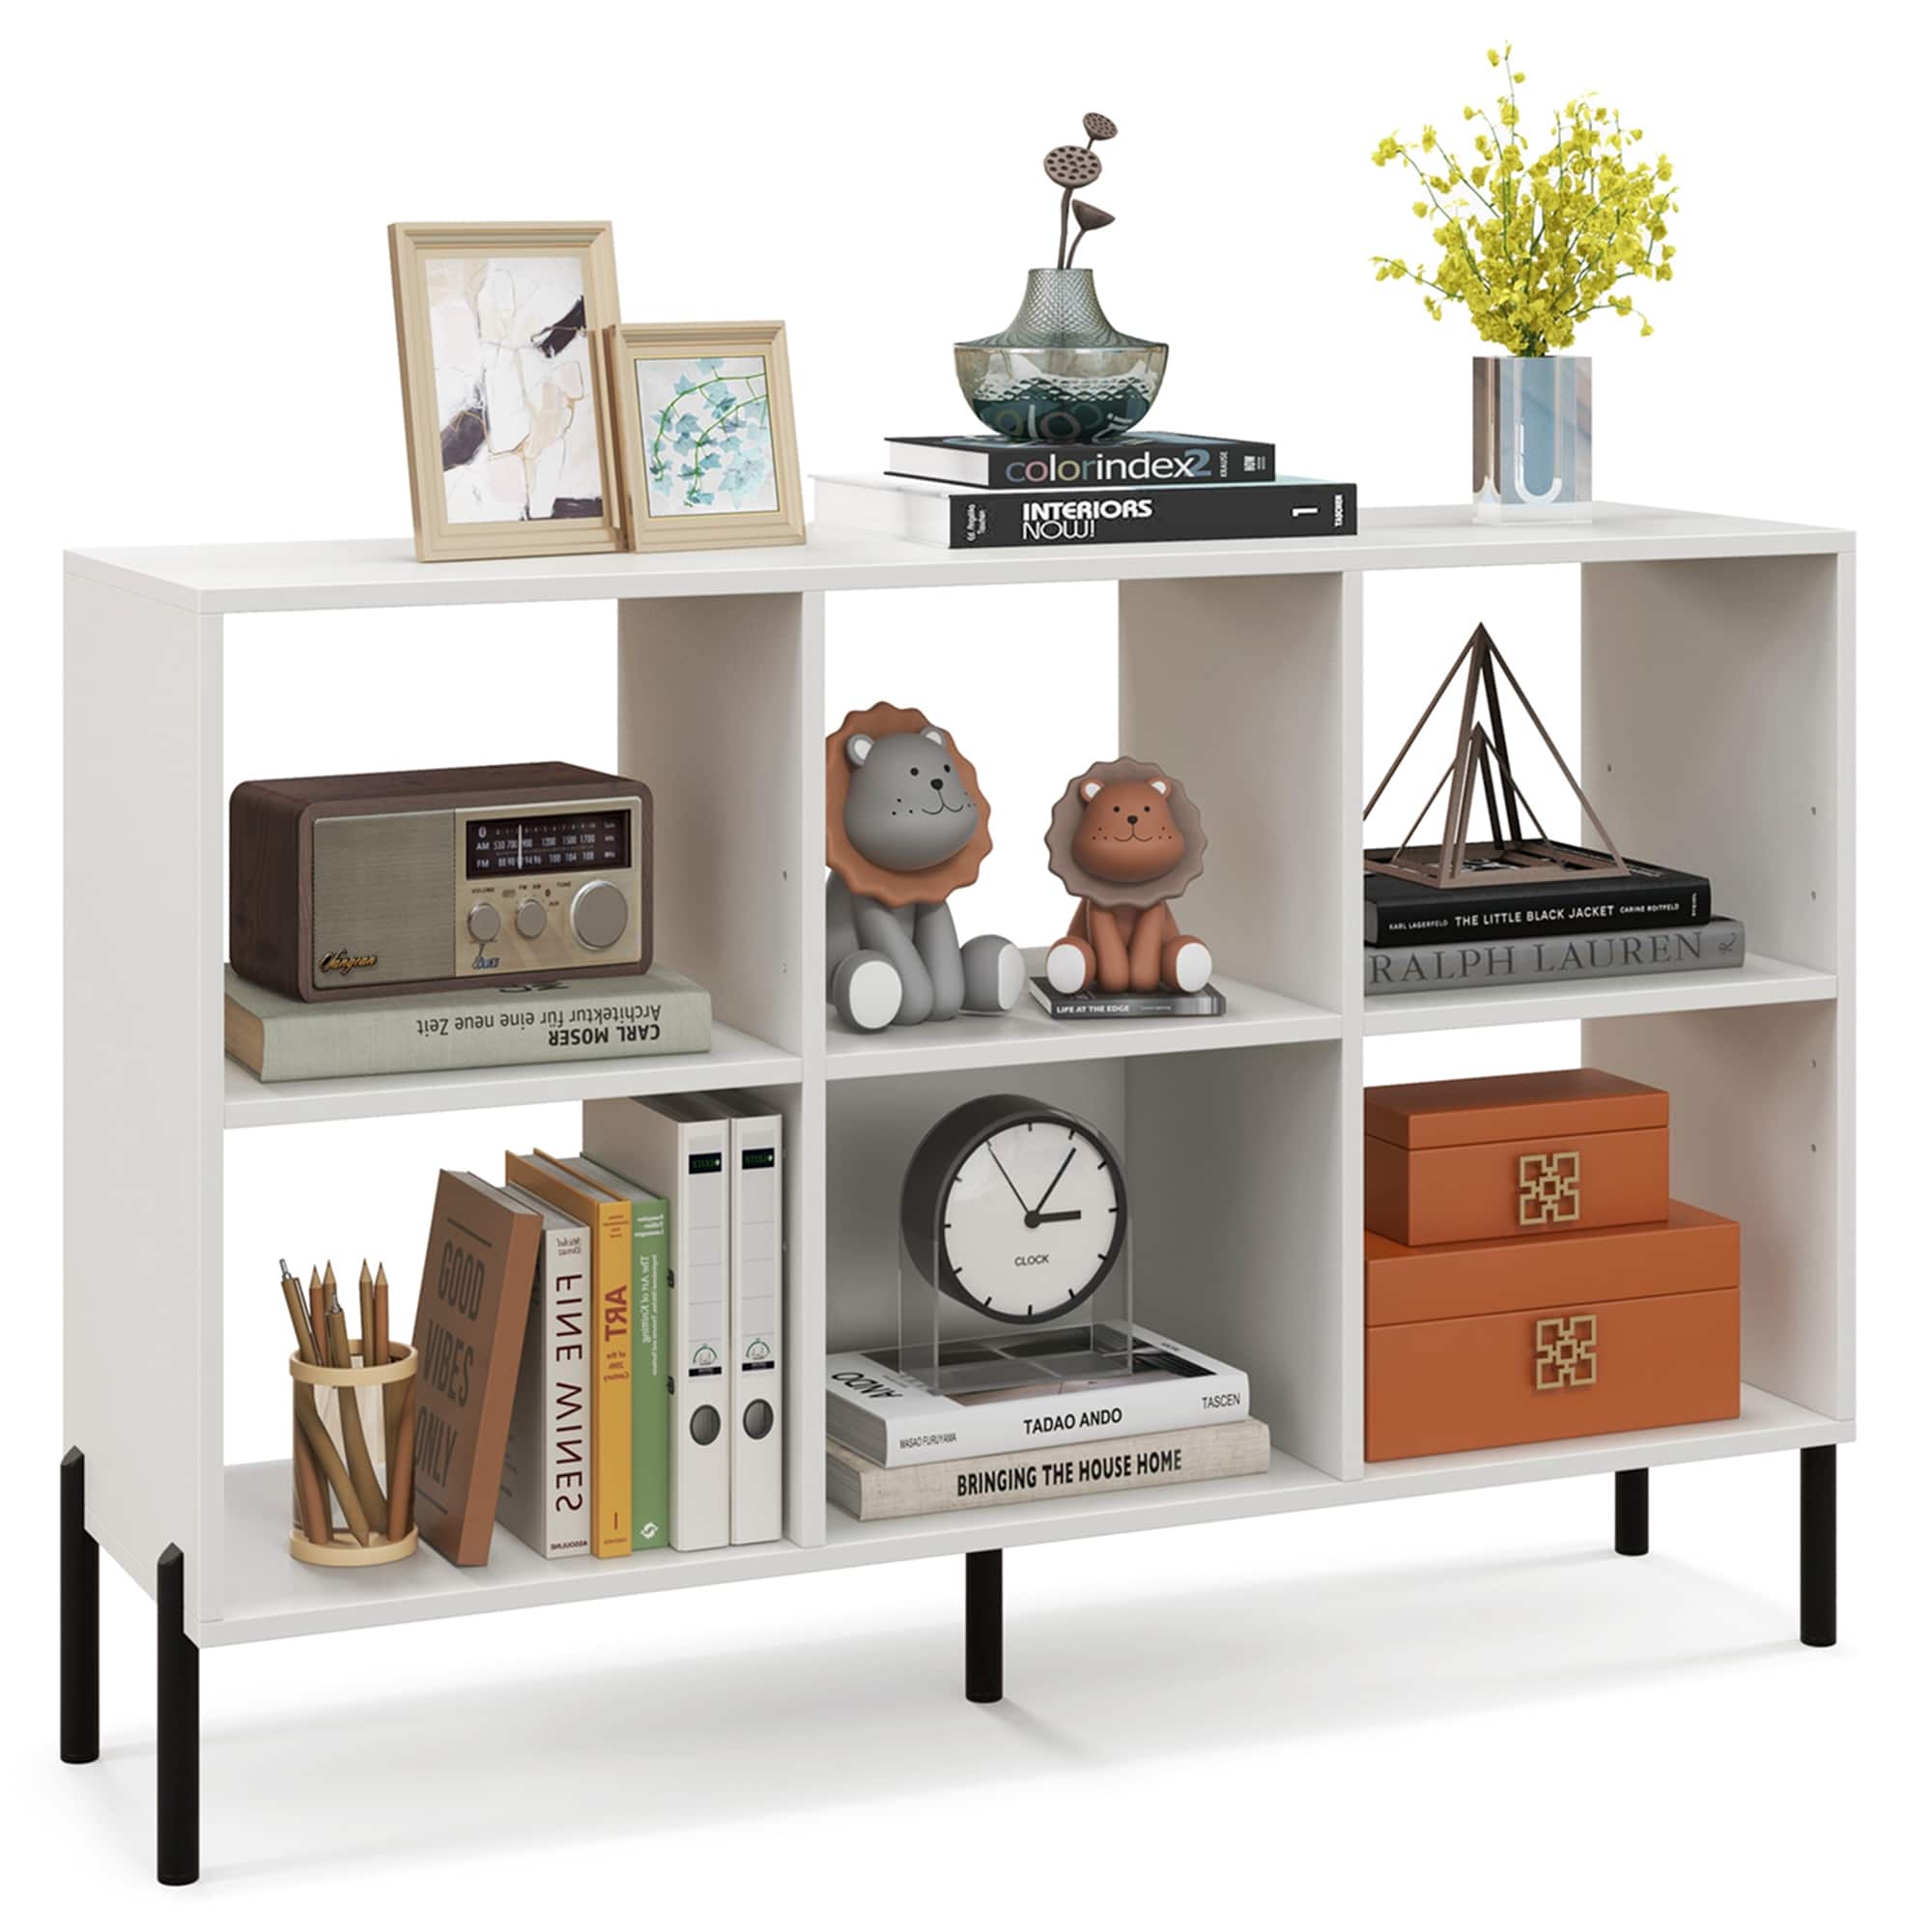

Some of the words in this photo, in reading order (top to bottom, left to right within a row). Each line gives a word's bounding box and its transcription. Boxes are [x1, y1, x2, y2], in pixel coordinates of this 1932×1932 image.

[1006, 449, 1211, 482] colorindex2
[1023, 499, 1153, 522] INTERIORS
[1292, 507, 1319, 518] 1
[1023, 520, 1094, 540] NOW!
[476, 841, 490, 850] AM
[476, 859, 490, 867] FM
[1455, 914, 1479, 927] THE
[1483, 911, 1522, 925] LITTLE
[1526, 908, 1565, 923] BLACK
[1568, 905, 1615, 920] JACKET
[1368, 945, 1516, 984] RALPH
[1532, 931, 1703, 973] LAUREN
[455, 1015, 495, 1031] neue
[500, 1012, 535, 1030] eine
[540, 1010, 563, 1028] für
[569, 1005, 662, 1025] Architektur
[416, 1018, 449, 1037] Zeit
[549, 1026, 610, 1046] MOSER
[616, 1024, 661, 1042] CARL
[1014, 1254, 1050, 1266] CLOCK
[438, 1239, 486, 1322] GOOD
[423, 1318, 475, 1407] VIBES
[1024, 1413, 1076, 1435] TADAO
[1079, 1407, 1122, 1428] ANDO
[415, 1406, 458, 1489] ONLY
[957, 1466, 1037, 1496] BRINGING
[1042, 1462, 1074, 1486] THE
[1079, 1455, 1131, 1482] HOUSE
[1136, 1449, 1182, 1474] HOME
